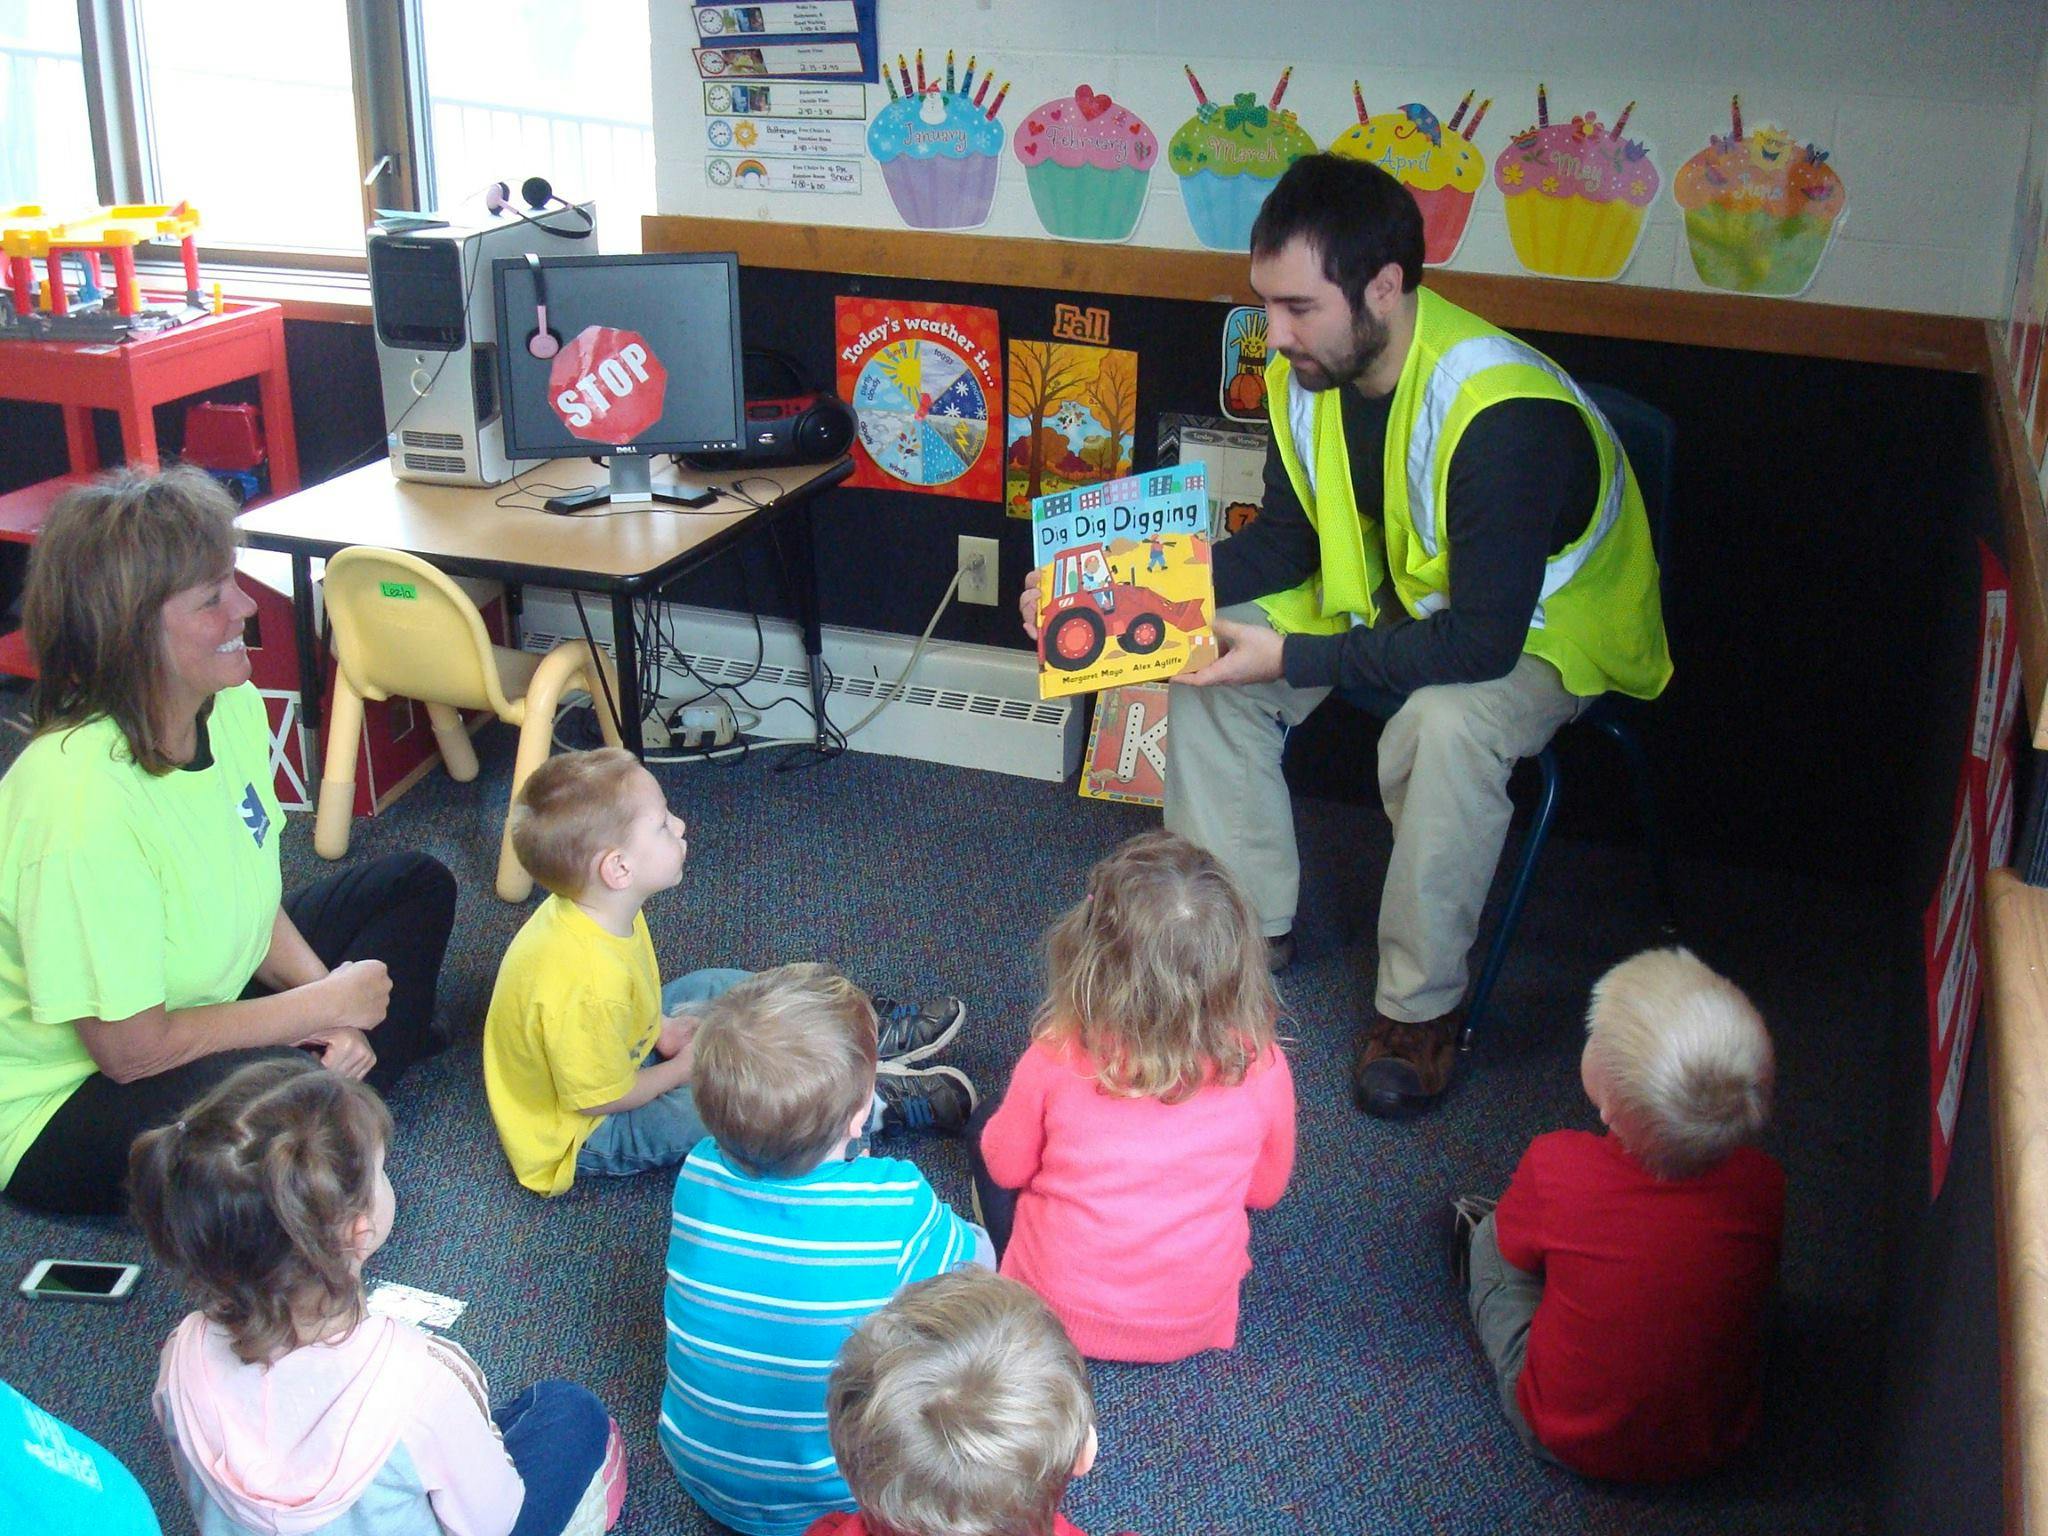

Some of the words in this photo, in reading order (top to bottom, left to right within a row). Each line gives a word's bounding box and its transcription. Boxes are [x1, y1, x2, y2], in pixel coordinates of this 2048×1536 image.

[903, 124, 968, 150] January
[1046, 126, 1130, 163] February
[1207, 136, 1279, 163] March
[1376, 144, 1432, 179] April
[1550, 151, 1602, 193] May
[1056, 308, 1108, 341] Fall
[841, 316, 900, 365] Today's
[904, 317, 976, 353] weather
[973, 350, 994, 388] is...
[934, 348, 954, 365] foggy
[557, 343, 650, 428] STOP
[868, 377, 881, 401] cloudy
[860, 421, 874, 446] cloudy
[615, 446, 638, 454] DELL
[889, 462, 910, 478] windy
[1041, 525, 1068, 546] Dig
[1075, 514, 1106, 538] Dig
[1113, 501, 1197, 534] Digging
[1062, 671, 1099, 685] Margaret
[1101, 667, 1123, 680] Mayo
[1132, 661, 1151, 672] Alex
[1117, 702, 1168, 783] K
